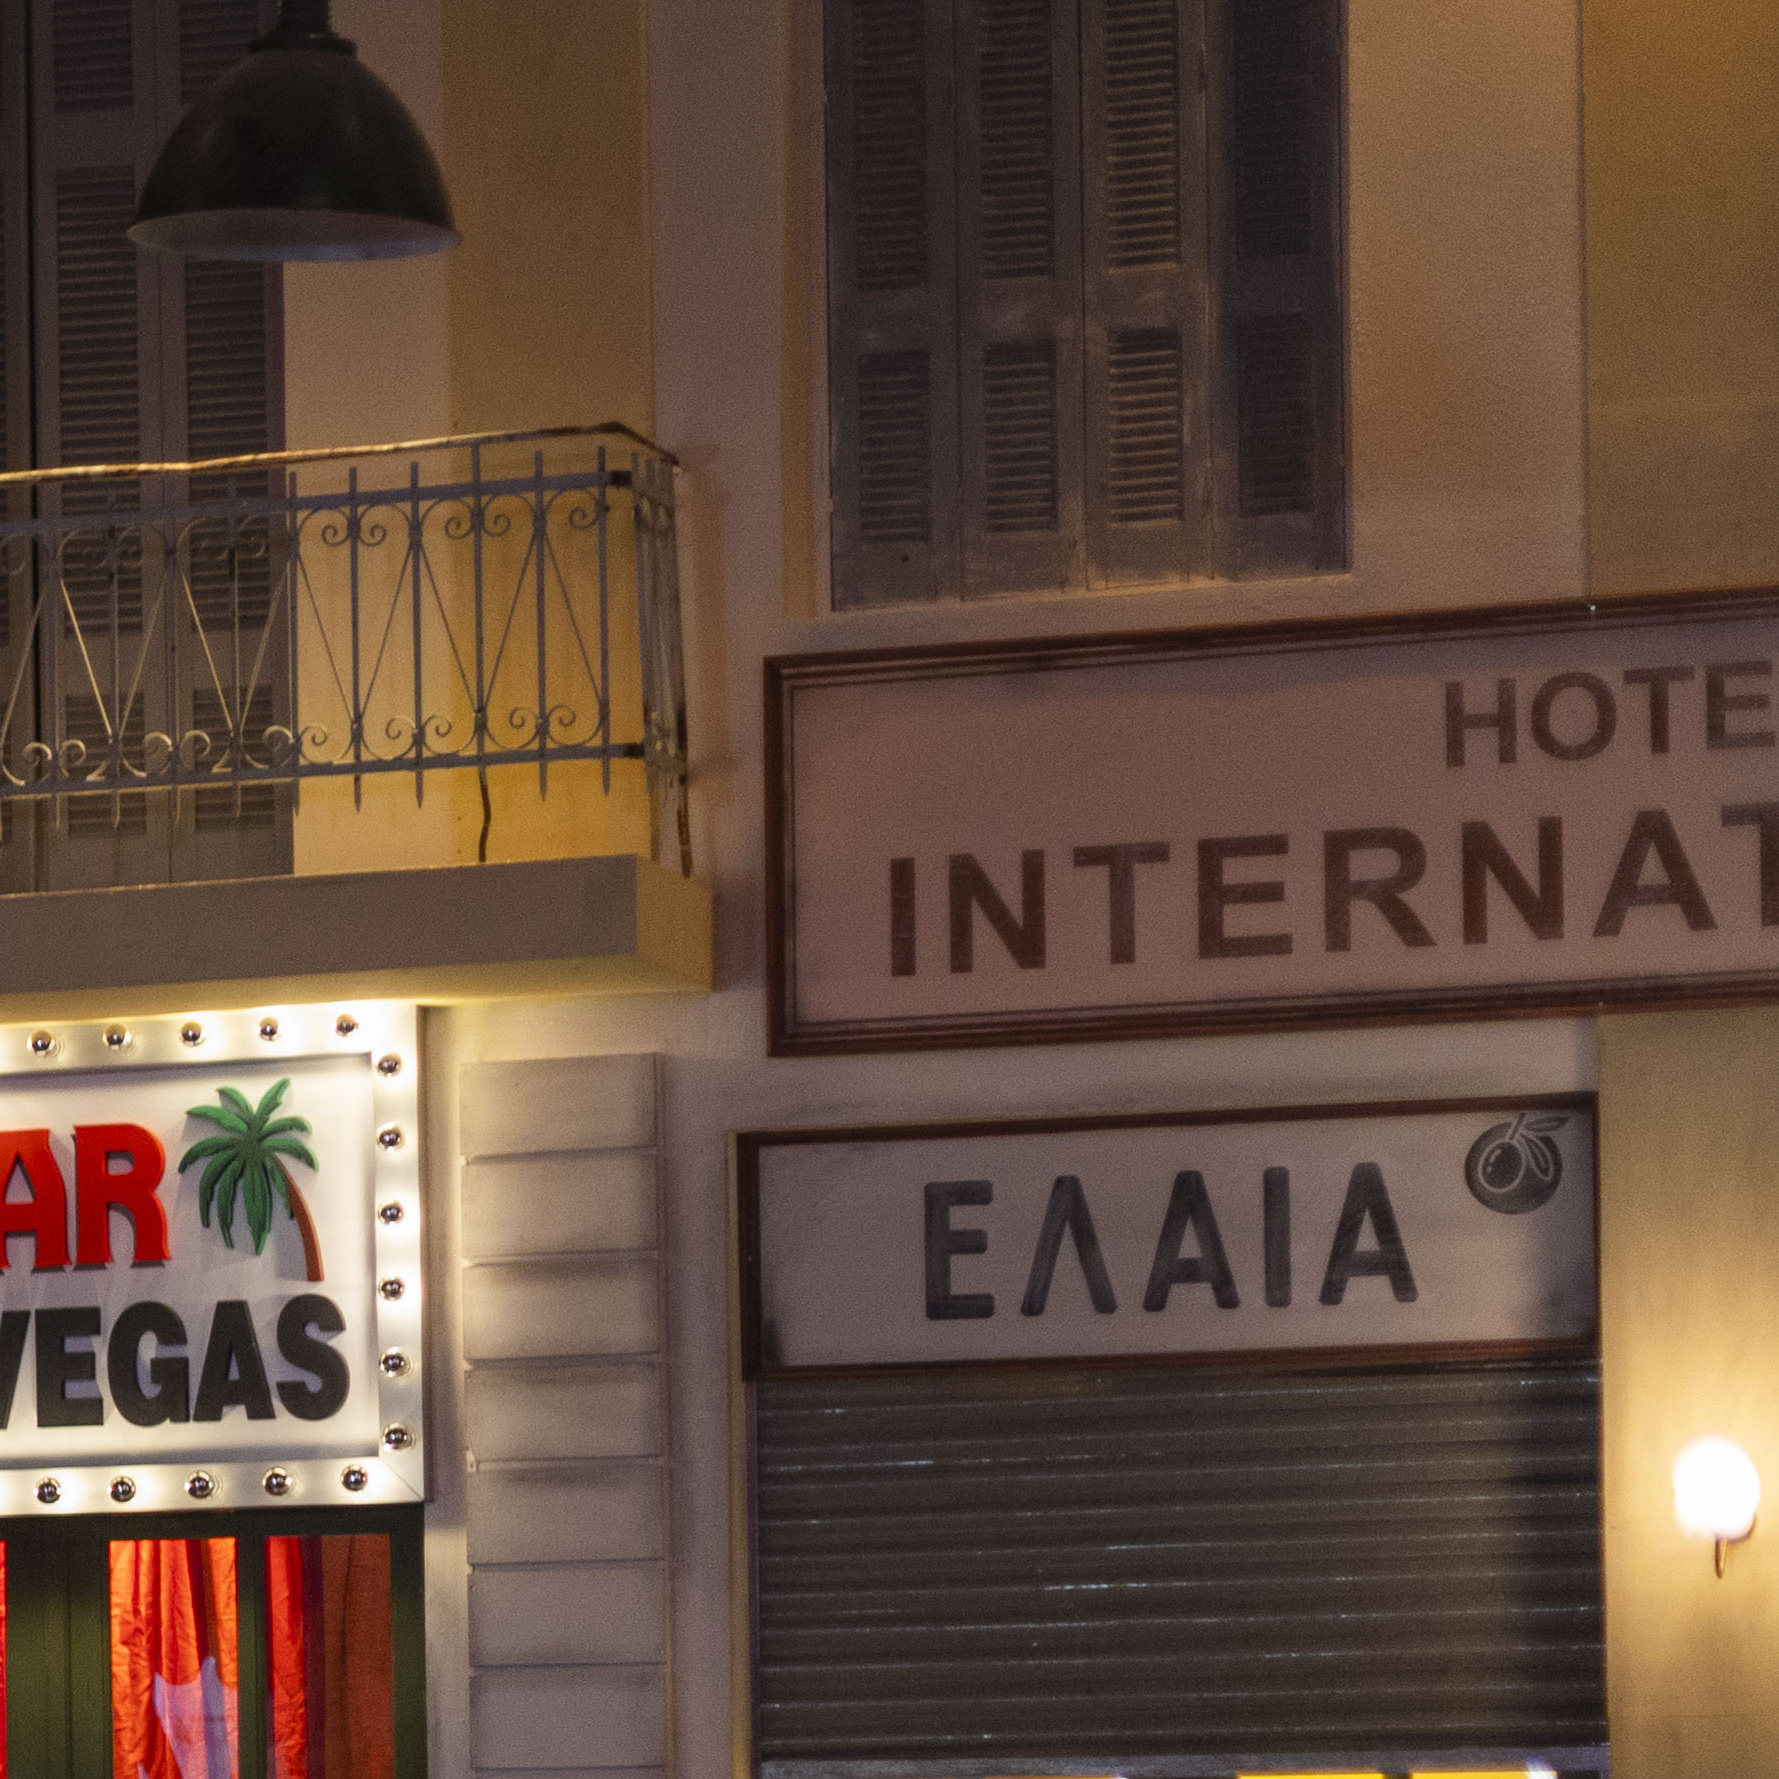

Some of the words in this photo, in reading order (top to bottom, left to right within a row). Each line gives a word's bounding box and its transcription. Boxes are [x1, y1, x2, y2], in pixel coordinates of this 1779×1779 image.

[1443, 659, 1777, 768] HOTE
[888, 800, 1779, 979] INTERNAT
[923, 1160, 1419, 1322] ΕΛΑΙΑ
